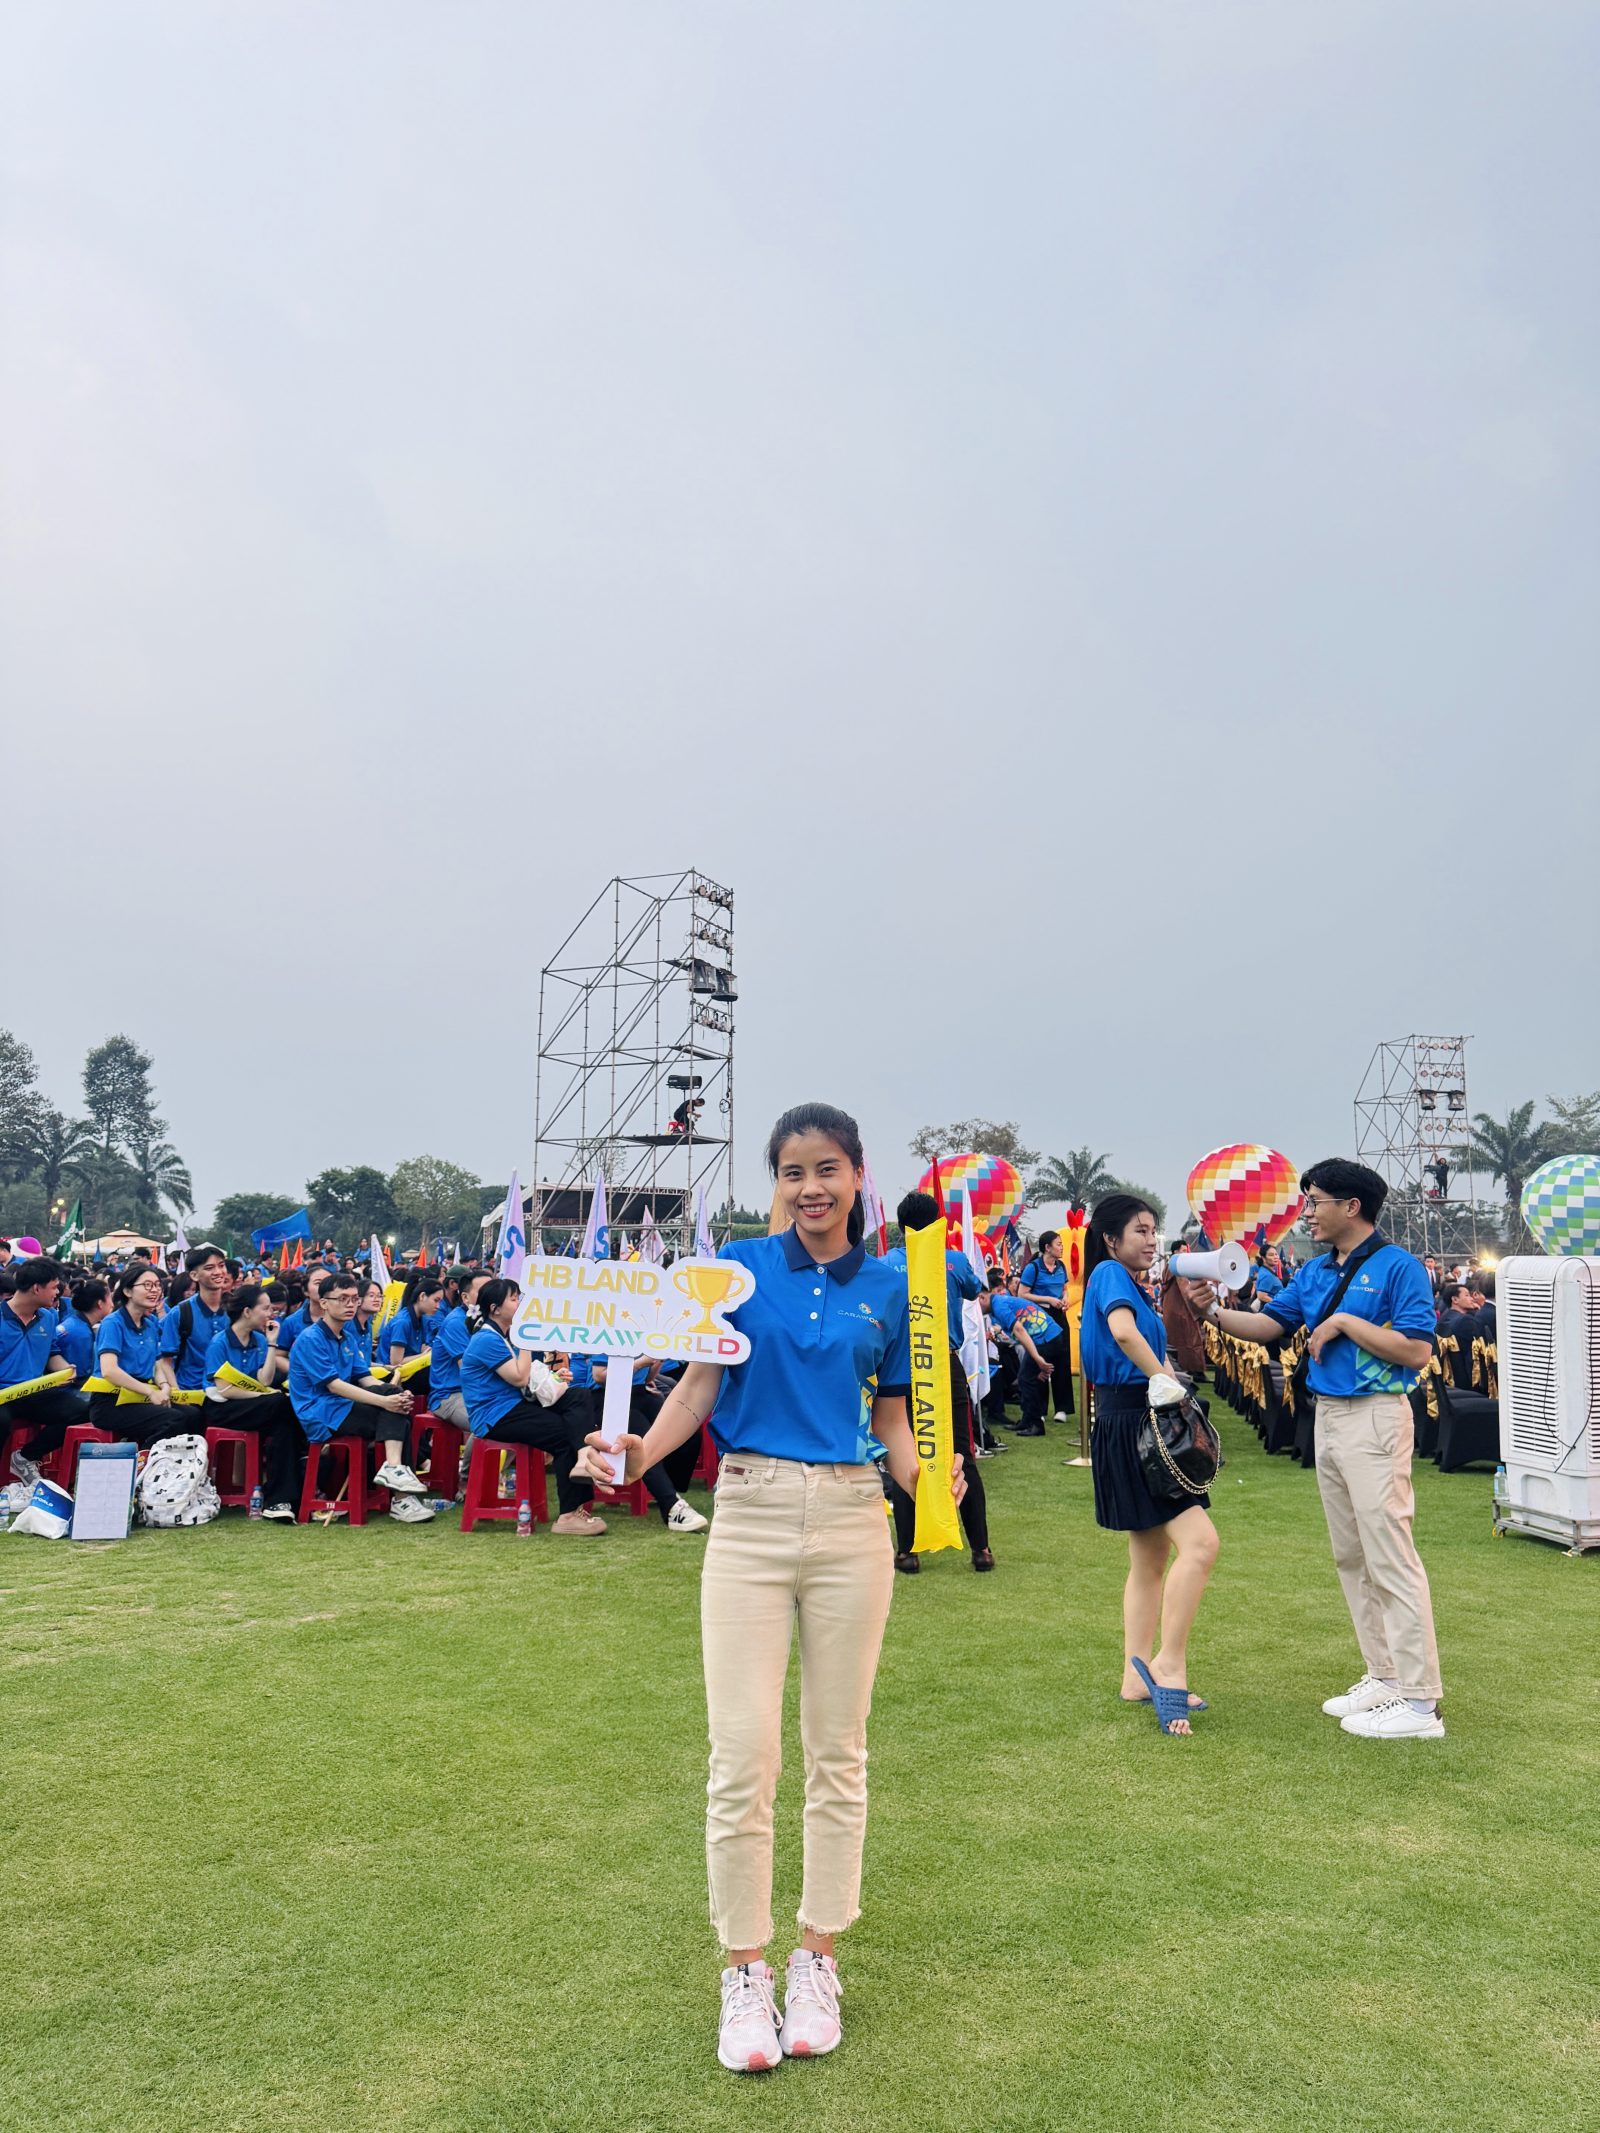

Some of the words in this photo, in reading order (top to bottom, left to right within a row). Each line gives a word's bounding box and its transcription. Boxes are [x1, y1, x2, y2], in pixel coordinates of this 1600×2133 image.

[527, 1263, 573, 1291] HB
[577, 1266, 659, 1295] LAND
[521, 1297, 581, 1325] ALL
[586, 1301, 616, 1327] IN
[517, 1323, 741, 1356] CARAWORLD
[913, 1332, 933, 1370] HB
